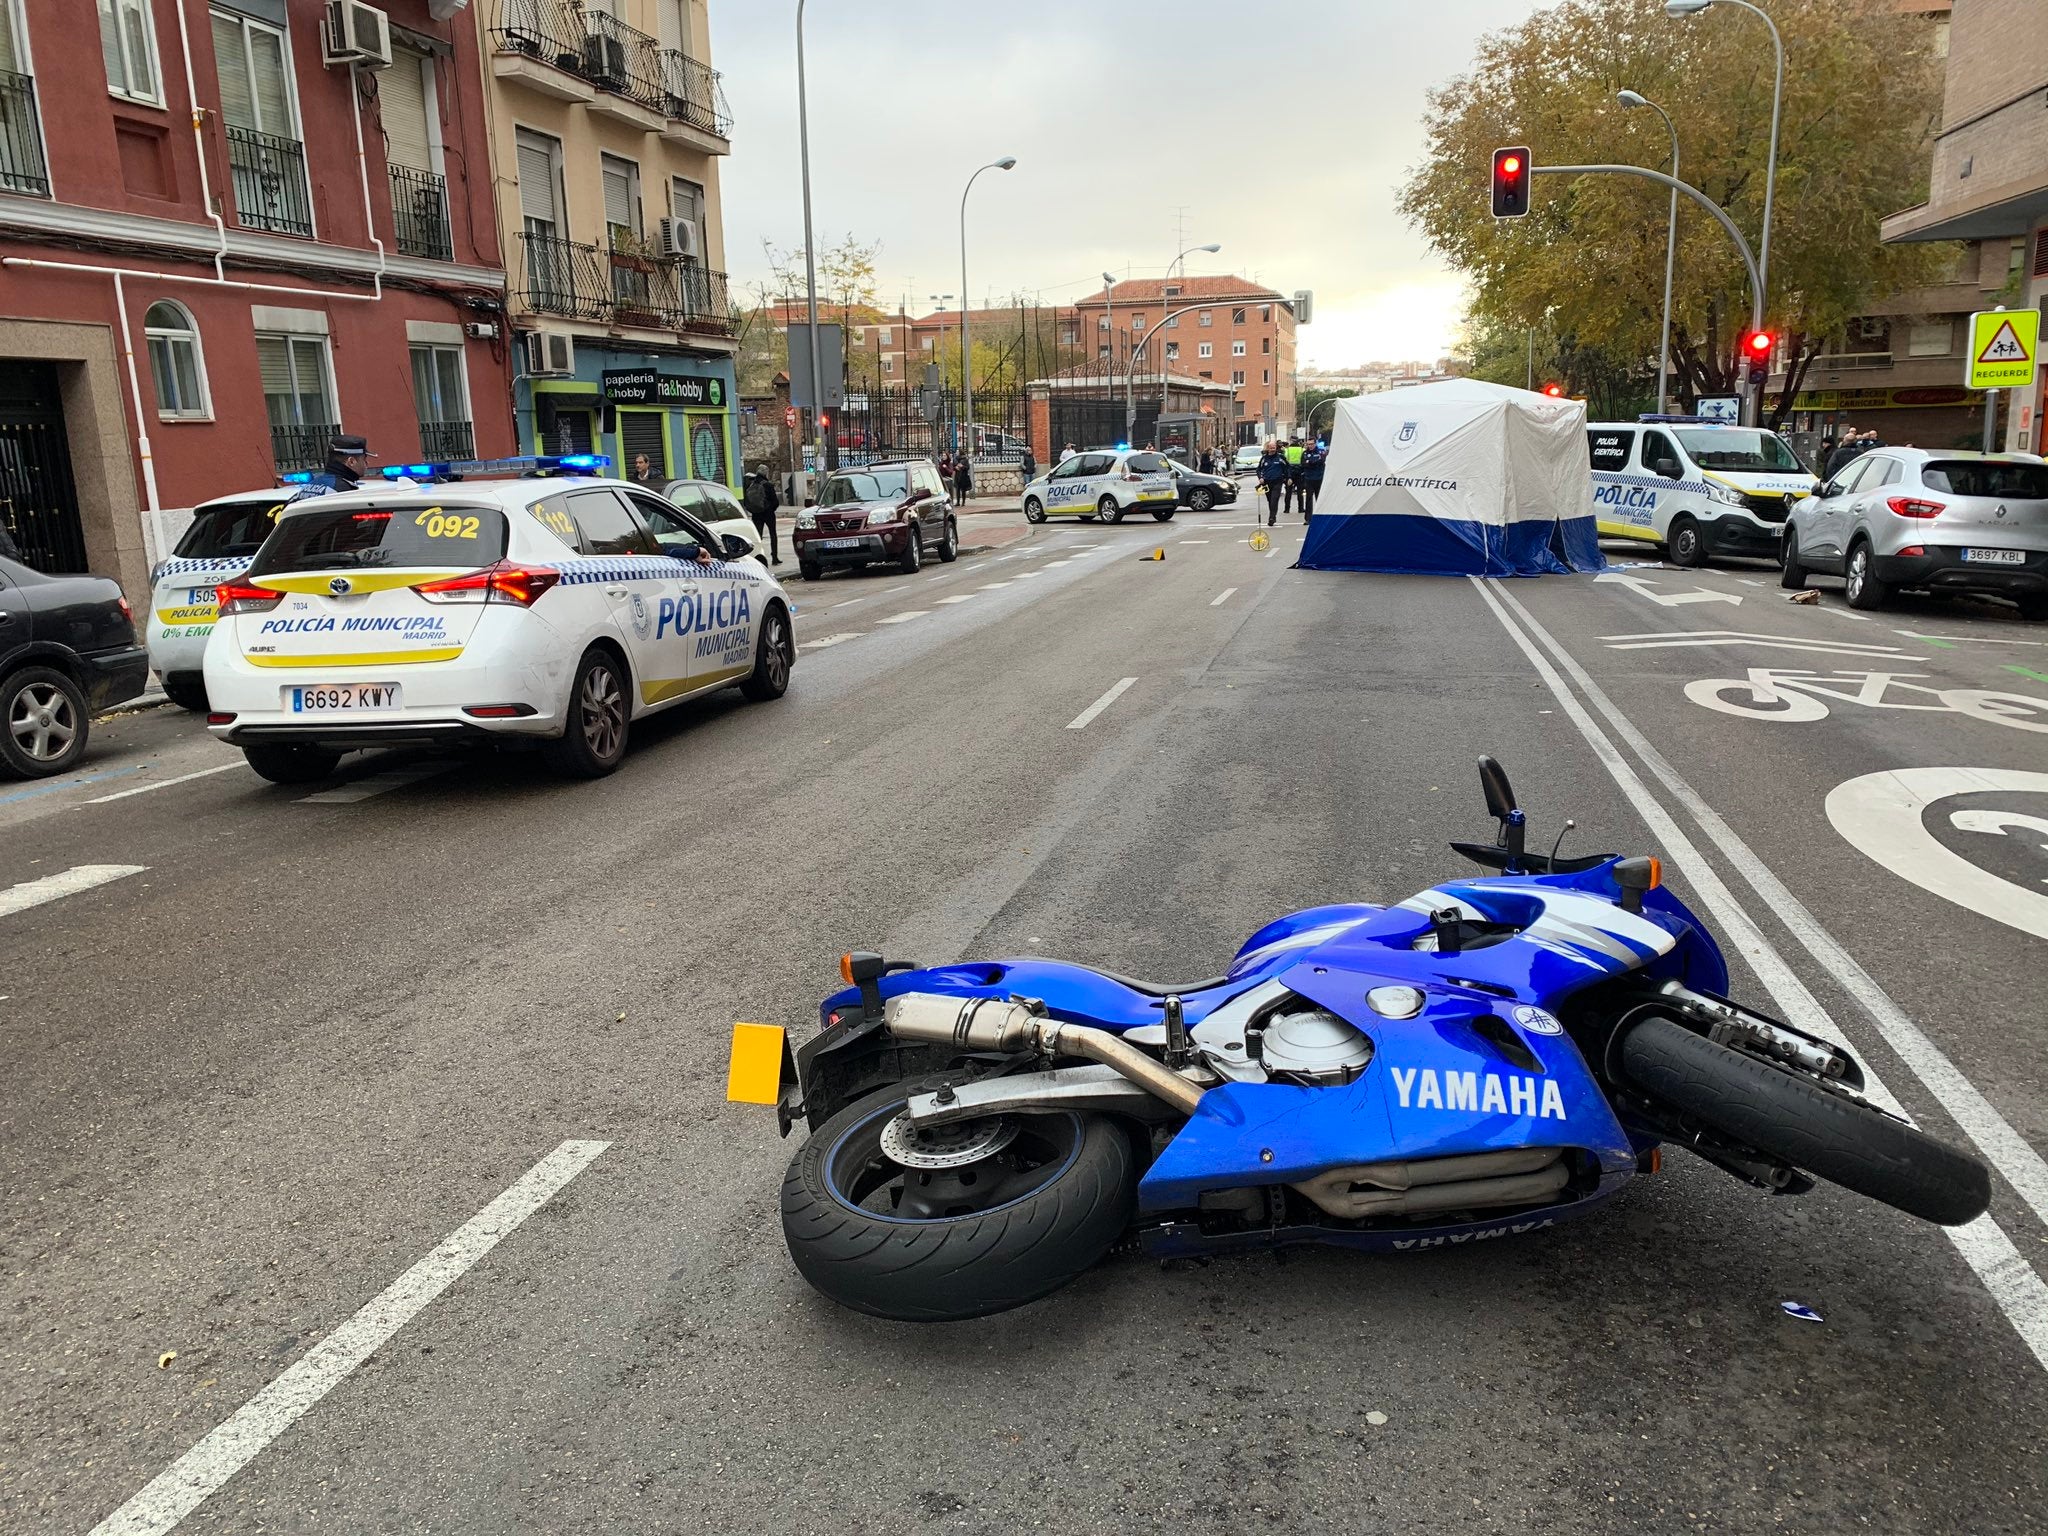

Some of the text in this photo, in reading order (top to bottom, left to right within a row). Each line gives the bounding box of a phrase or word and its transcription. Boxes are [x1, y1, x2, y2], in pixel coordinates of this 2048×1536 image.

[1976, 369, 2028, 378] RECUERDE
[607, 388, 646, 399] &hobby
[1346, 475, 1457, 490] POLICÍA CIENTÍFICA
[1593, 486, 1657, 509] POLICÍA
[545, 511, 575, 533] 112
[1613, 506, 1653, 519] MUNICIPAL
[427, 515, 480, 539] 092
[1970, 550, 2022, 561] 3697 KBL
[171, 606, 212, 618] POLICÍA
[293, 602, 308, 610] 7034
[656, 581, 751, 640] POLICÍA
[162, 627, 181, 639] 0%
[261, 614, 444, 634] POLICÍA MUNICIPAL
[402, 631, 446, 640] MADRID
[695, 626, 751, 658] MUNICIPAL
[723, 647, 750, 666] MADRID
[304, 687, 395, 709] 6692 KWY
[1390, 1067, 1567, 1121] YAMAHA
[1392, 1218, 1556, 1249] YAMAHA
